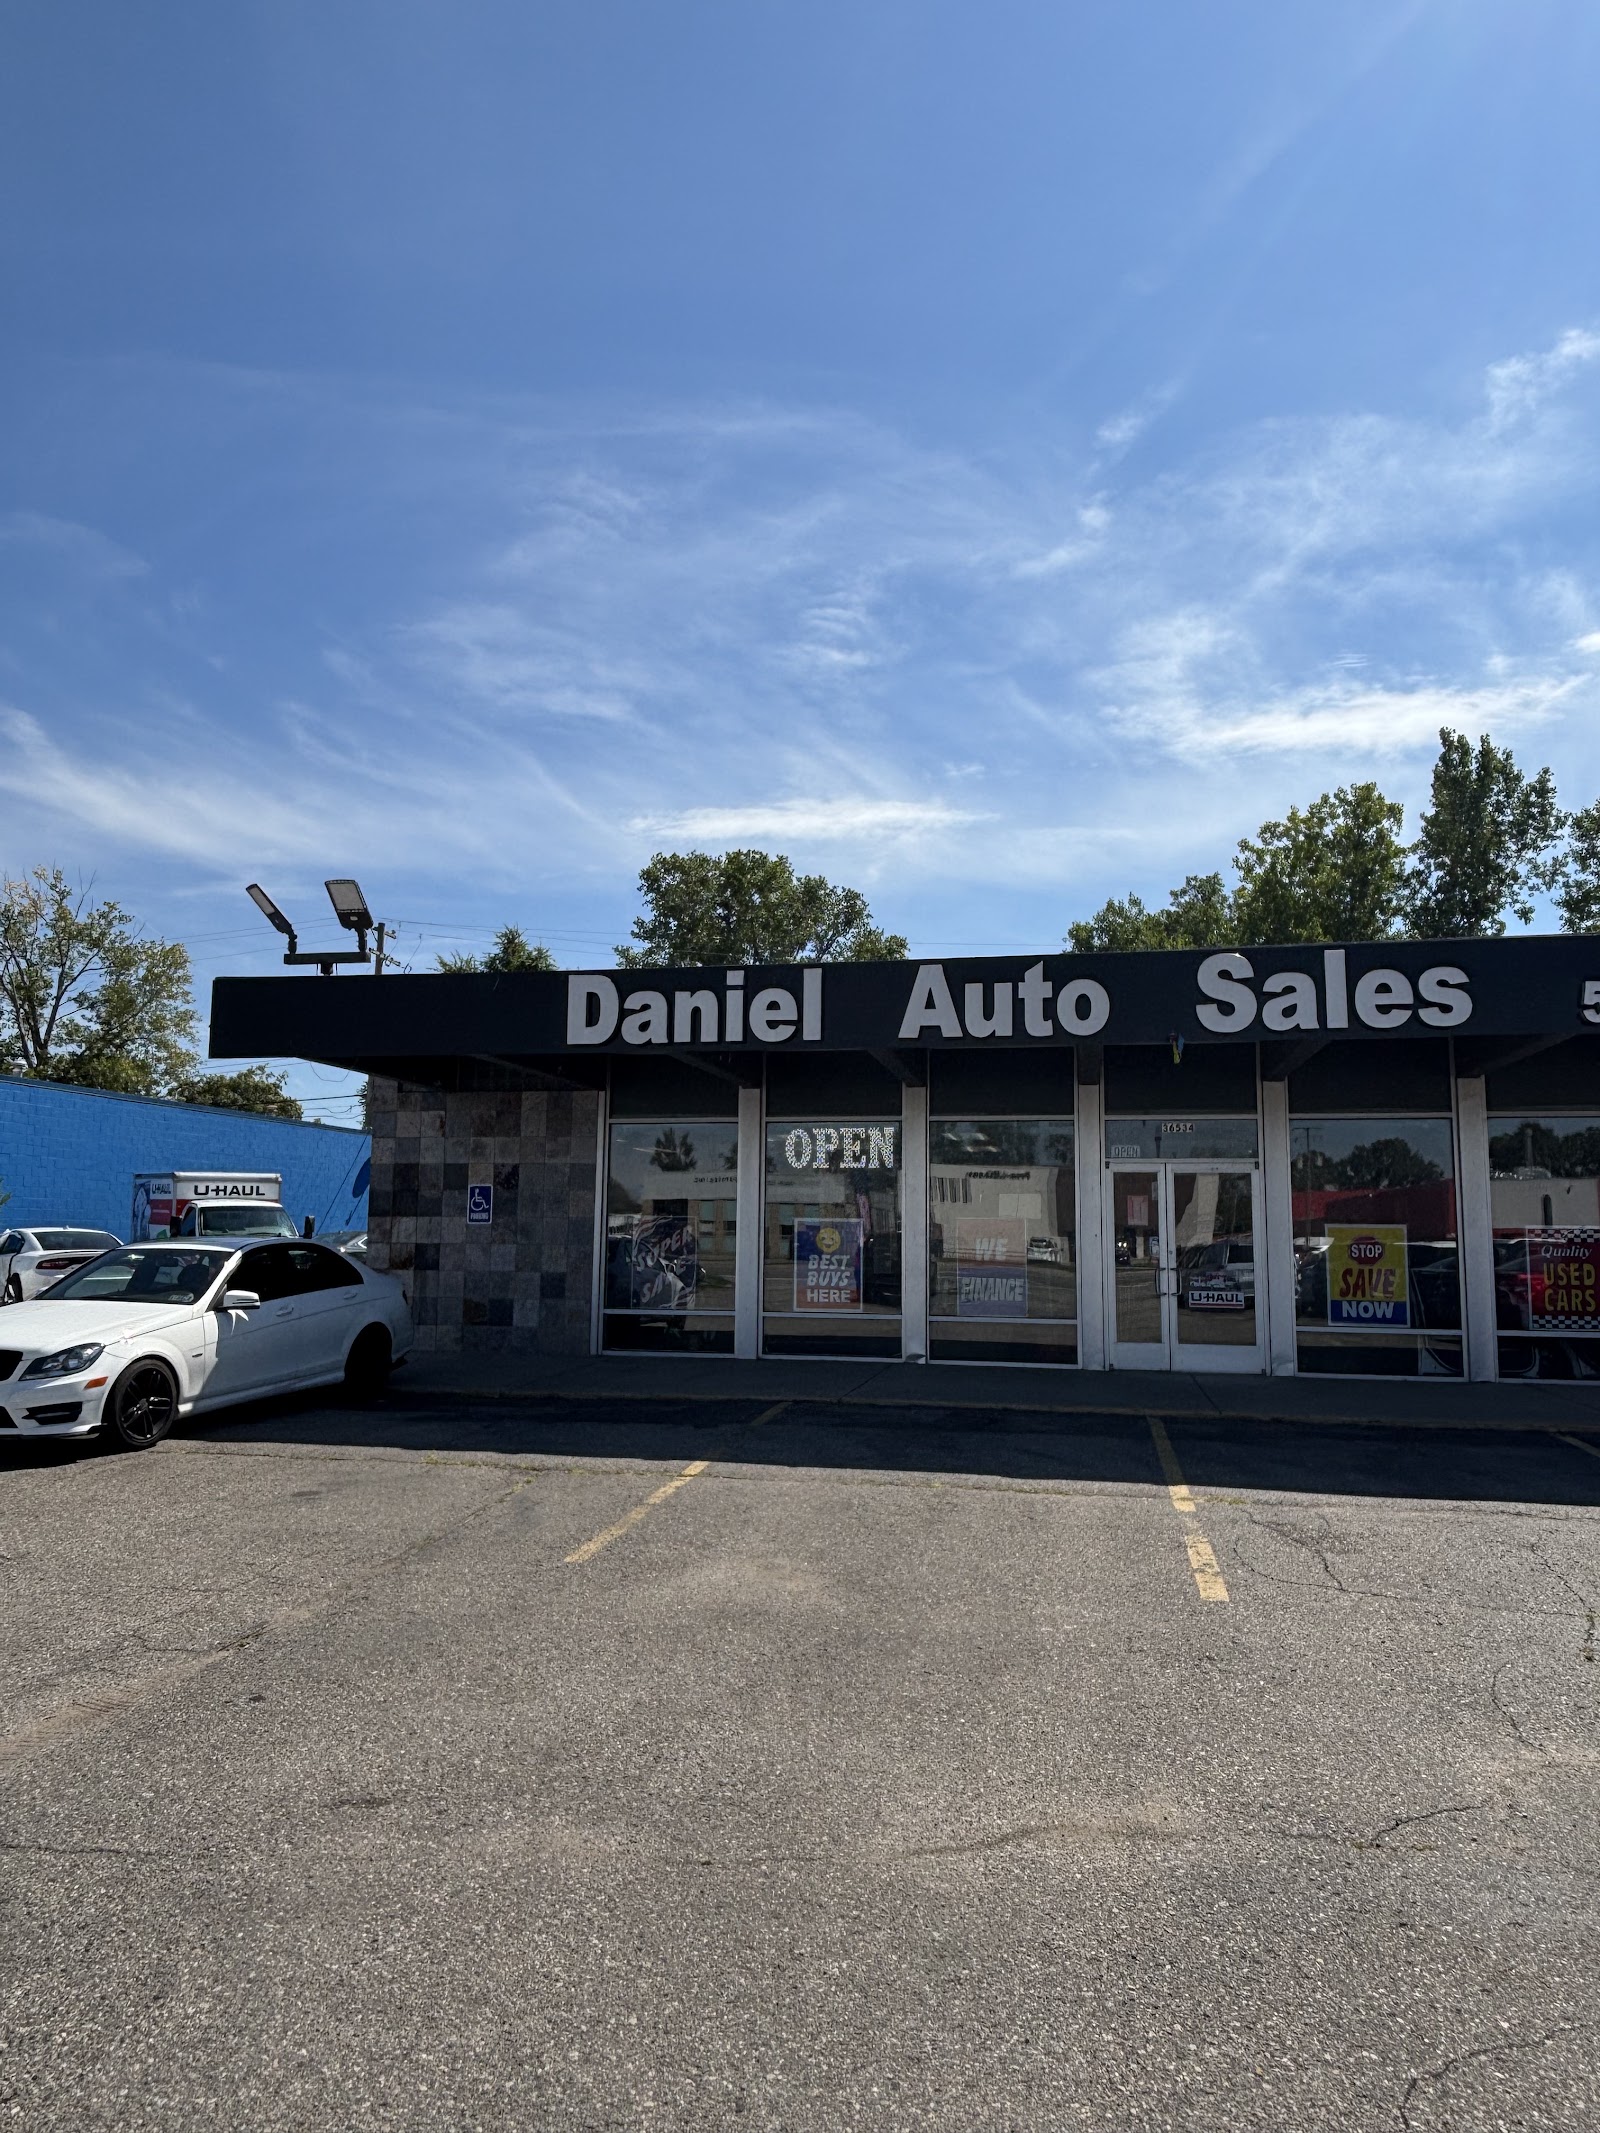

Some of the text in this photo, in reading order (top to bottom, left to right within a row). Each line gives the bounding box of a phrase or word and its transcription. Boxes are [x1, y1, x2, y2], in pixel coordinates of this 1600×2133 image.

[567, 968, 822, 1045] Daniel
[898, 960, 1110, 1038] Auto
[1196, 949, 1473, 1033] Sales
[785, 1127, 894, 1168] OPEN
[193, 1185, 266, 1196] U-HAUL
[975, 1238, 1009, 1261] WE
[1351, 1244, 1382, 1258] STOP
[1541, 1245, 1592, 1259] Quality
[808, 1254, 851, 1270] BEST
[807, 1271, 851, 1287] BUYS
[1340, 1267, 1396, 1298] SAVE
[1543, 1263, 1596, 1286] USED
[806, 1288, 851, 1303] HERE
[961, 1277, 1024, 1301] FINANCE
[1190, 1292, 1243, 1303] U-HAUL
[1544, 1288, 1596, 1312] CARS
[1342, 1301, 1394, 1318] NOW
